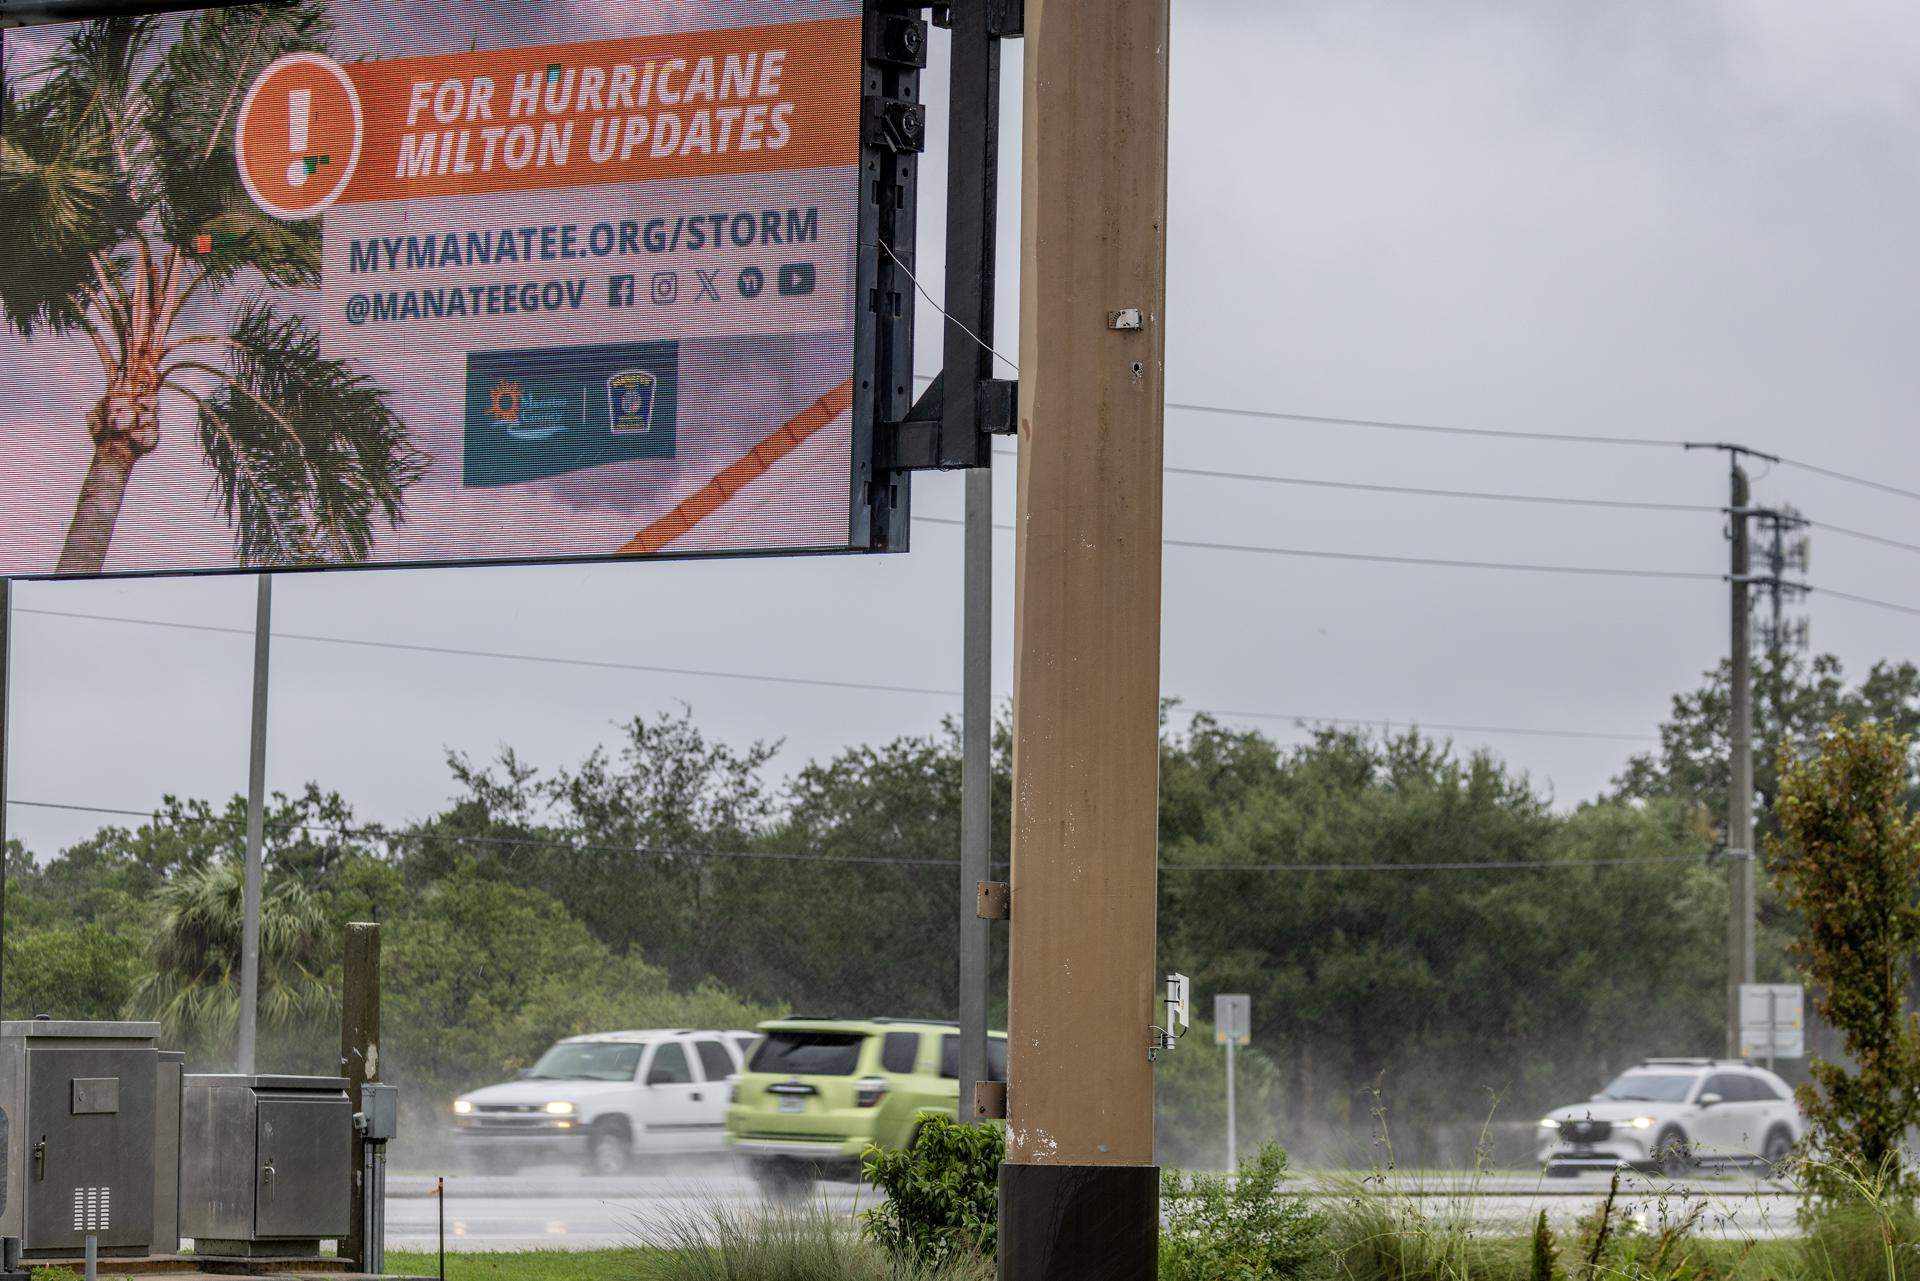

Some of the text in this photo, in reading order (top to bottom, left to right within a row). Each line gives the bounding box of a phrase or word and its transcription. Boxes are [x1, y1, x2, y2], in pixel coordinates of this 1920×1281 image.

[406, 50, 787, 127] FOR HURRICANE
[394, 102, 795, 179] MILTON UPDATES
[350, 207, 818, 273] MYMANATEE.ORG/STORM
[345, 279, 587, 325] @MANATEEGOV
